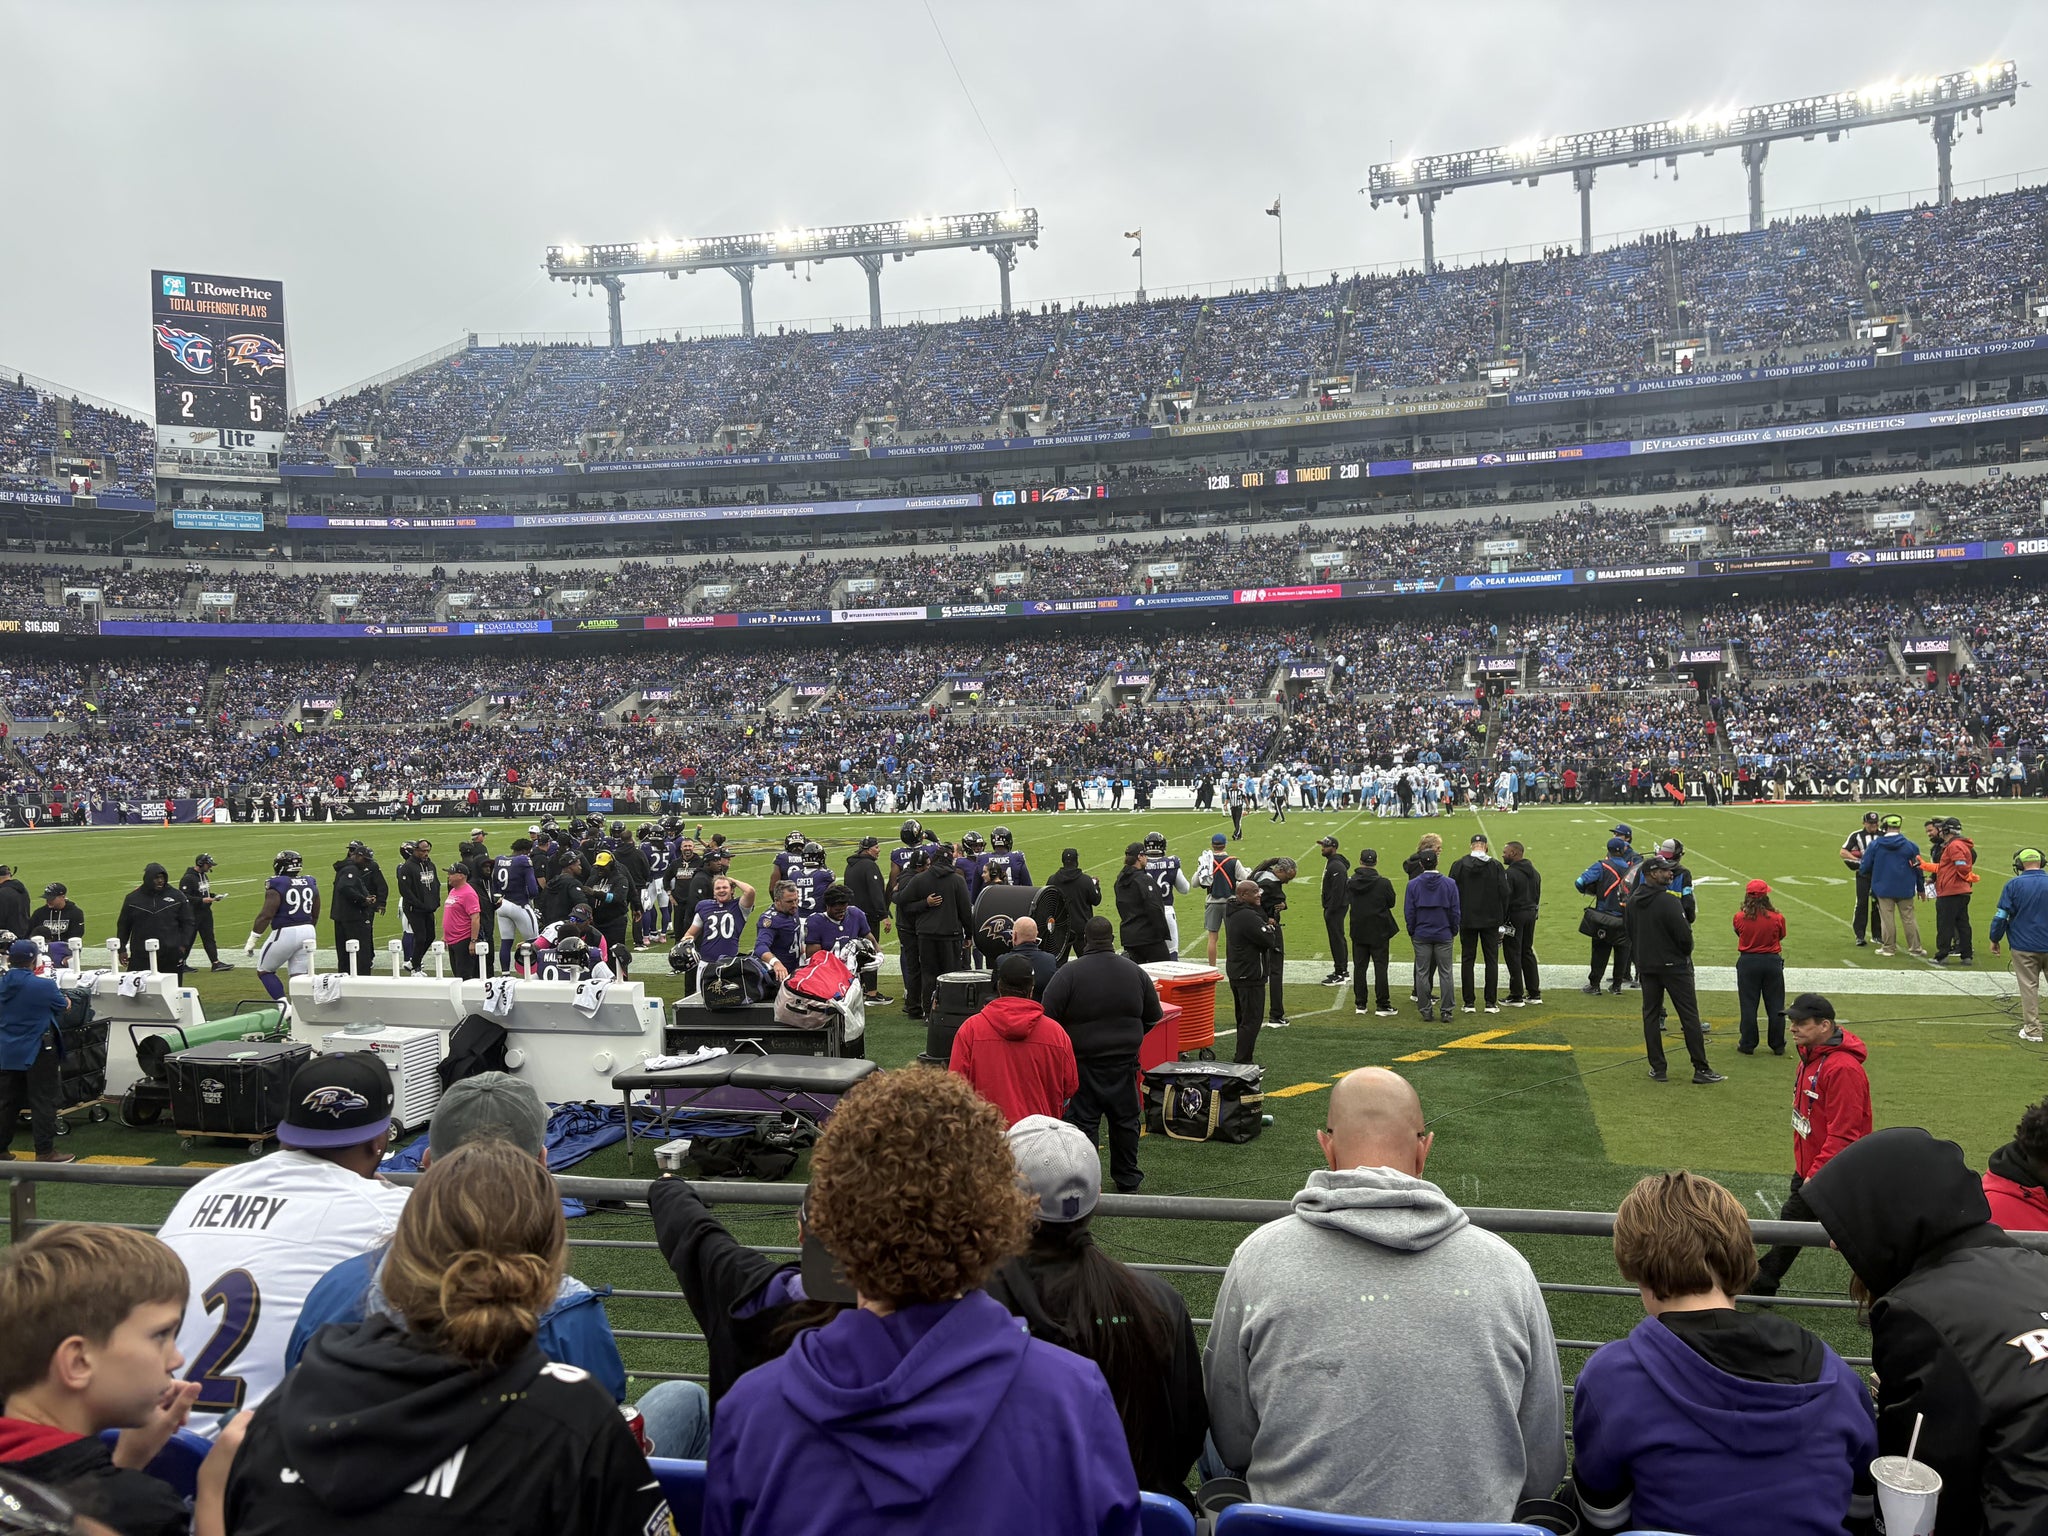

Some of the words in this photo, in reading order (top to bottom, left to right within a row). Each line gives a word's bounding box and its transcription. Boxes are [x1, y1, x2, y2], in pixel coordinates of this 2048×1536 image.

[169, 298, 196, 312] TOTAL
[196, 299, 240, 316] OFFENSIVE
[241, 304, 267, 318] PLAYS
[1913, 351, 1942, 361] BRIAN
[1944, 346, 1981, 358] BILLICK
[1983, 339, 2036, 354] 1999-2007
[1764, 368, 1789, 378] TODD
[1791, 365, 1816, 375] HEAP
[1818, 359, 1868, 372] 2001-2010
[1637, 383, 1666, 393] JAMAL
[1667, 378, 1694, 389] LEWIS
[1695, 374, 1742, 385] 2000-2006
[1515, 393, 1537, 403] MATT
[1538, 390, 1569, 400] STOVER
[1572, 386, 1615, 398] 1996-2008
[181, 391, 194, 417] 2
[250, 396, 262, 422] 5
[1405, 405, 1416, 413] ED
[1418, 402, 1439, 412] REED
[1440, 399, 1484, 410] 2002-2012
[1305, 414, 1320, 422] RAY
[1322, 412, 1347, 421] LEWIS
[1348, 408, 1391, 418] 1996-2012
[1182, 423, 1222, 434] JONATHAN
[1222, 420, 1249, 430] OGDEN
[1251, 417, 1291, 427] 1996-2007
[189, 431, 218, 444] Miller
[216, 428, 256, 450] Lite
[1033, 438, 1054, 446] PETER
[1055, 435, 1093, 445] BOULWARE
[1094, 432, 1131, 441] 1997-2005
[1642, 440, 1659, 452] JEV
[1662, 438, 1706, 448] PLASTIC
[1708, 433, 1759, 444] SURGERY
[1762, 430, 1772, 440] &
[1776, 426, 1828, 438] MEDICAL
[1831, 418, 1906, 434] AESTHETICS
[888, 448, 916, 456] MICHAEL
[918, 446, 948, 454] McCRARY
[950, 443, 985, 452] 1997-2002
[1505, 453, 1526, 462] SMALL
[1527, 450, 1557, 461] BUSINESS
[779, 454, 806, 462] ARTHUR
[814, 452, 841, 460] MODELL
[498, 468, 520, 476] BYNER
[521, 467, 554, 475] 1996-2003
[589, 465, 609, 473] JOHNNY
[1296, 466, 1331, 482] TIMEOUT
[1340, 464, 1360, 479] 2:00
[1207, 475, 1230, 490] 12:09
[15, 493, 61, 504] 410-324-6141
[905, 498, 941, 508] Authentic
[942, 497, 969, 507] Artistry
[1021, 490, 1027, 503] 0
[523, 517, 537, 526] JEV
[538, 516, 570, 524] PLASTIC
[571, 515, 607, 523] SURGERY
[609, 514, 616, 522] &
[618, 513, 654, 521] MEDICAL
[656, 511, 707, 520] AESTHETICS
[722, 506, 814, 518] www.jevplasticsurgery.com
[413, 519, 430, 527] SMALL
[1876, 551, 1898, 562] SMALL
[1900, 549, 1935, 560] BUSINESS
[1937, 547, 1965, 558] PARTNERS
[1485, 577, 1505, 585] PEAK
[1508, 574, 1562, 584] MANAGEMENT
[1598, 569, 1644, 579] MALSTROM
[1646, 567, 1685, 576] ELECTRIC
[1054, 602, 1072, 610] SMALL
[1072, 601, 1097, 610] BUSINESS
[1195, 595, 1229, 603] ACCOUNTING
[952, 604, 1006, 613] SAFEGUARD
[777, 615, 821, 623] PATHWAYS
[24, 621, 60, 633] $16,690
[386, 626, 403, 634] SMALL
[529, 802, 565, 812] FLIGHT
[650, 852, 670, 872] 25
[497, 868, 509, 890] 9
[796, 877, 814, 886] GREEN
[286, 887, 314, 914] 98
[706, 912, 735, 940] 30
[189, 1194, 288, 1230] HENRY
